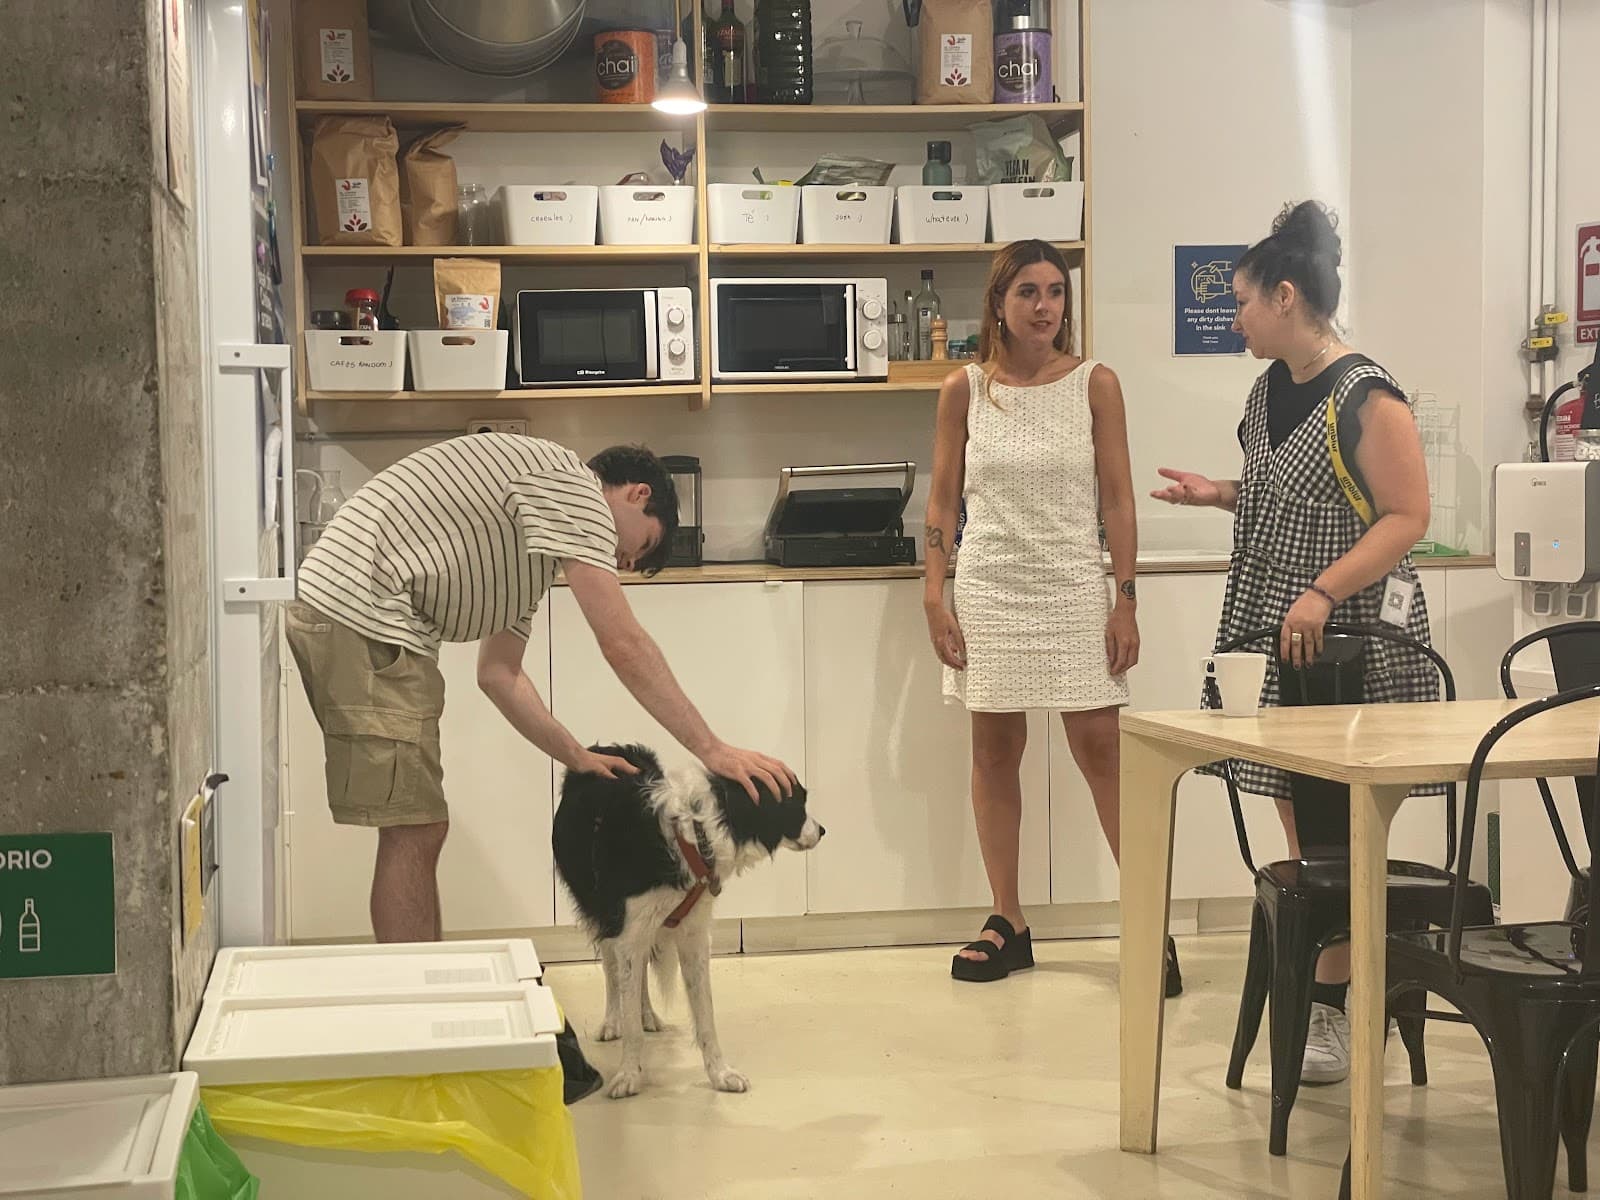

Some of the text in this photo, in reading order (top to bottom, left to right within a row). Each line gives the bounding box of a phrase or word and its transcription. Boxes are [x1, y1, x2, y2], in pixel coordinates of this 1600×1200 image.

[597, 55, 634, 76] chai
[998, 58, 1038, 78] chai
[1328, 422, 1338, 453] unblur
[1342, 476, 1362, 502] unblur
